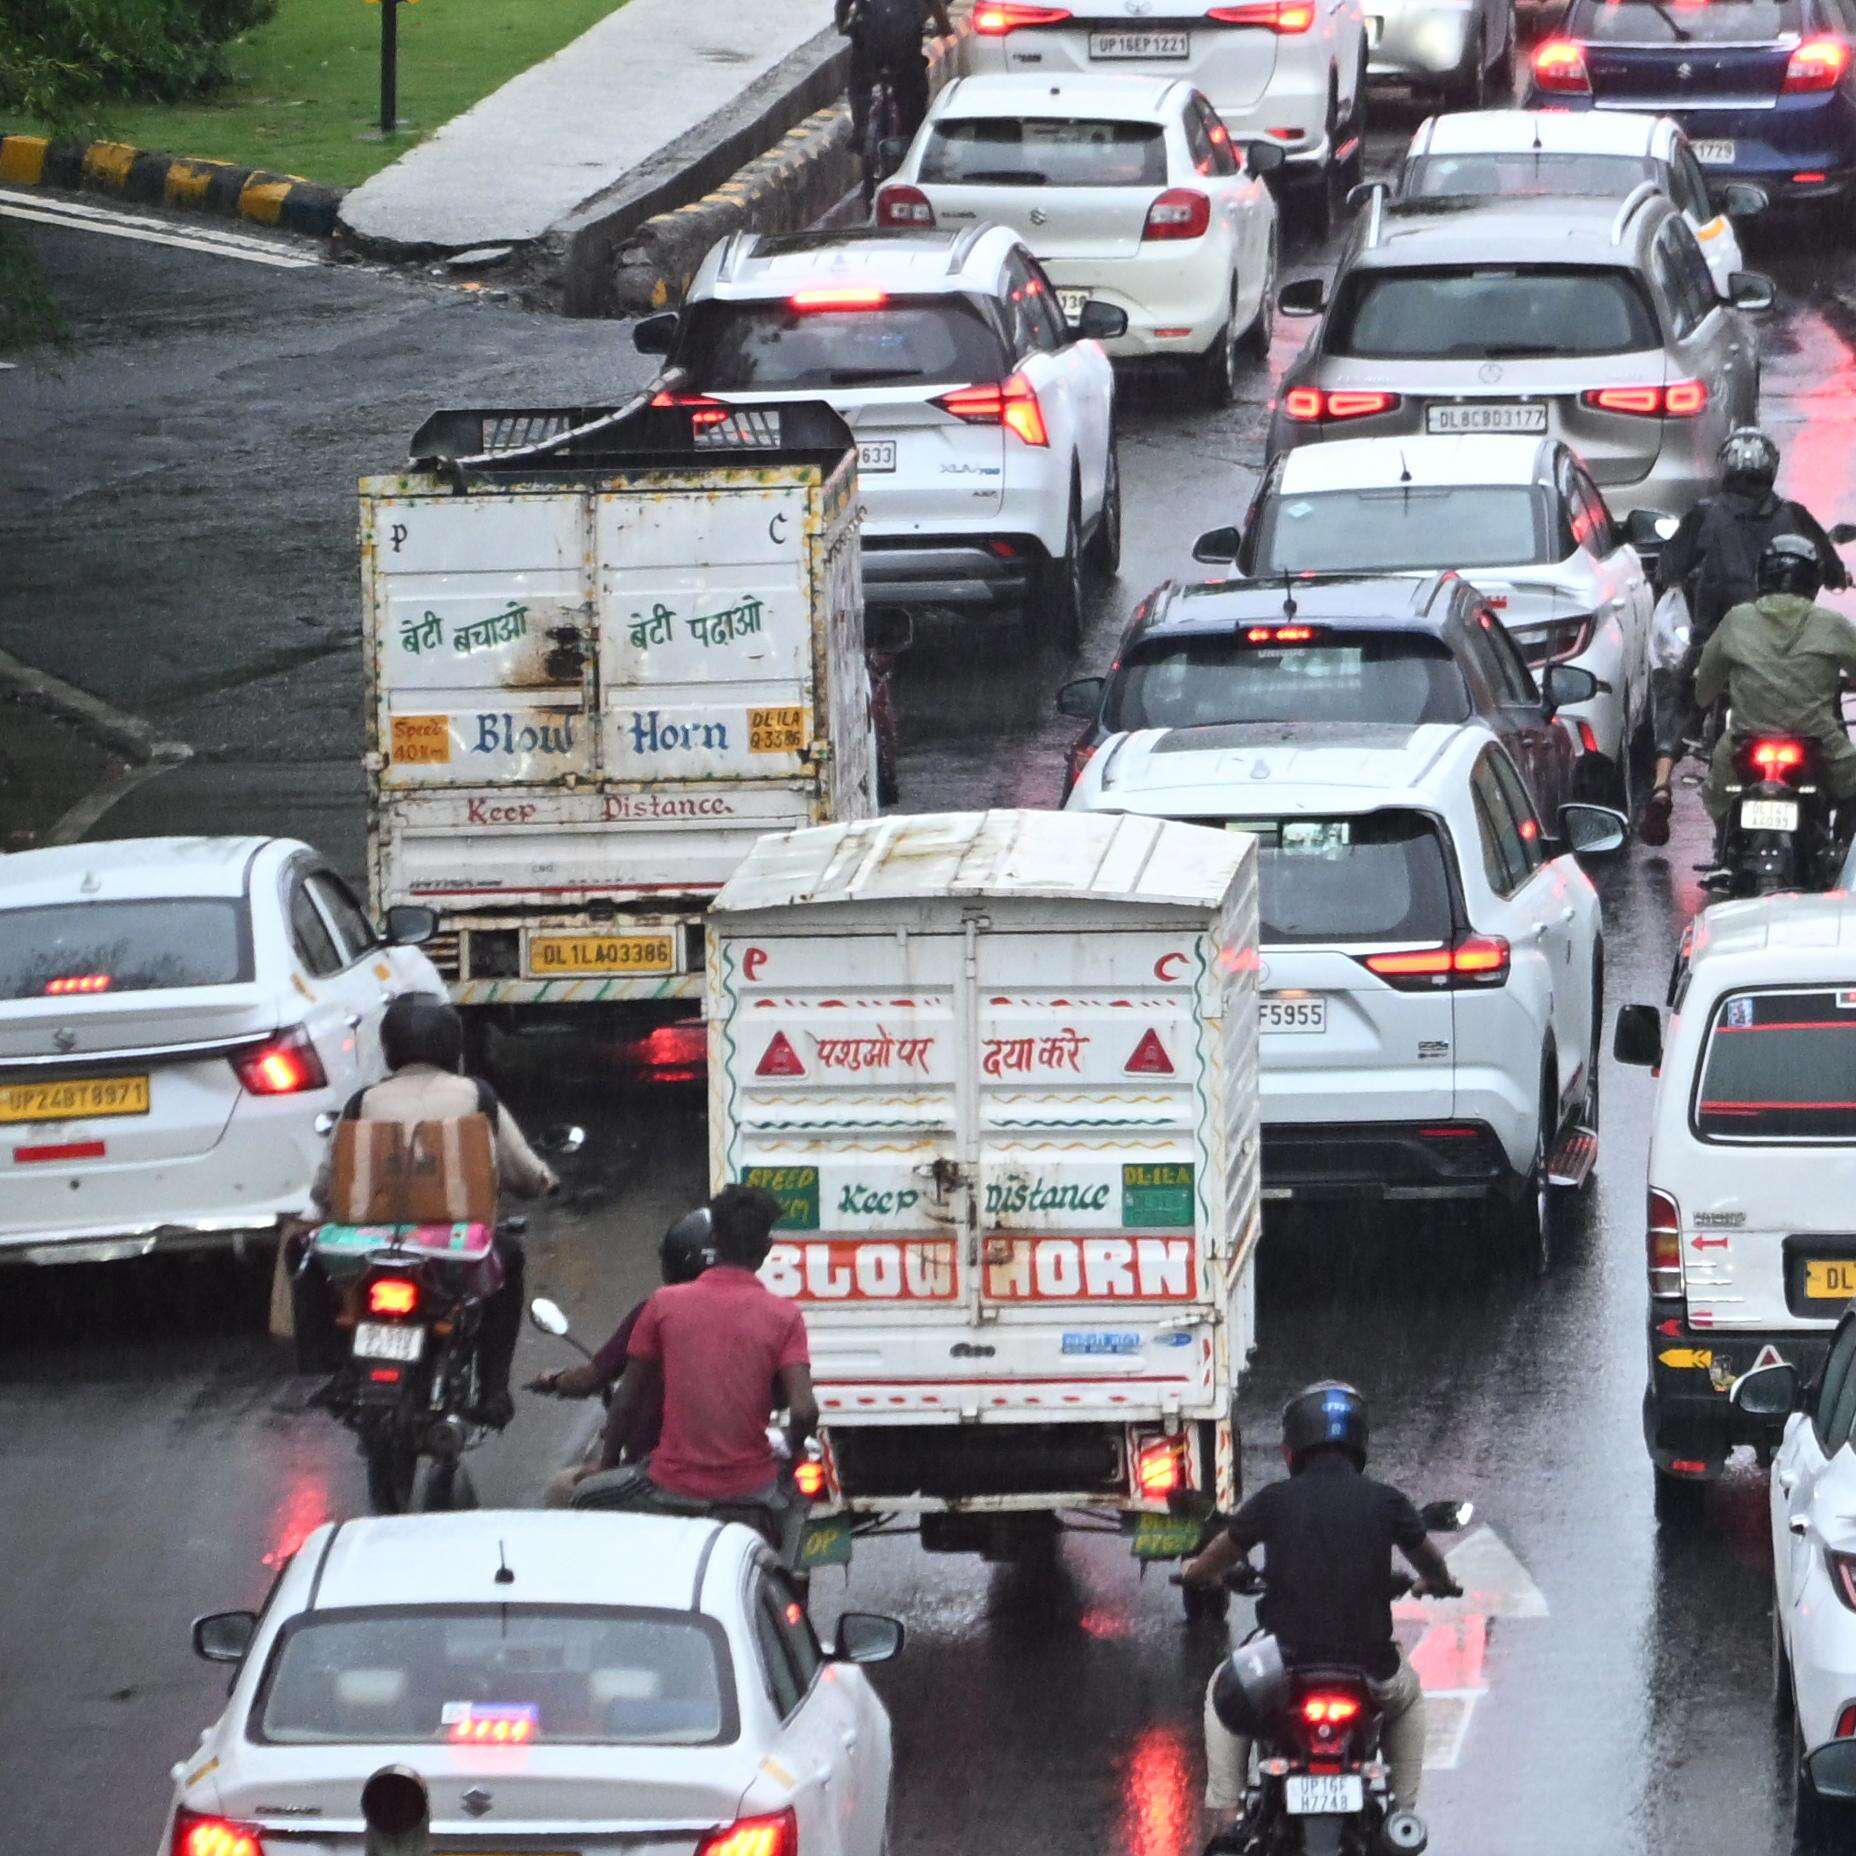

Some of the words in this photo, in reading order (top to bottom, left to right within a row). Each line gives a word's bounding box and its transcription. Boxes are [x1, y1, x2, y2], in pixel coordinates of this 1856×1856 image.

[389, 522, 408, 553] P
[768, 512, 788, 545] C
[400, 610, 445, 655] बेटी
[452, 601, 530, 654] बचाओ
[626, 602, 677, 651] बेटी
[631, 709, 729, 757] Horn
[467, 797, 537, 825] Keep
[1154, 951, 1190, 982] C
[896, 1038, 936, 1072] पर
[982, 1038, 1035, 1076] दया
[837, 1183, 919, 1217] Keep
[985, 1175, 1110, 1215] Distance
[757, 1244, 952, 1298] BLOW
[986, 1239, 1189, 1298] HORN
